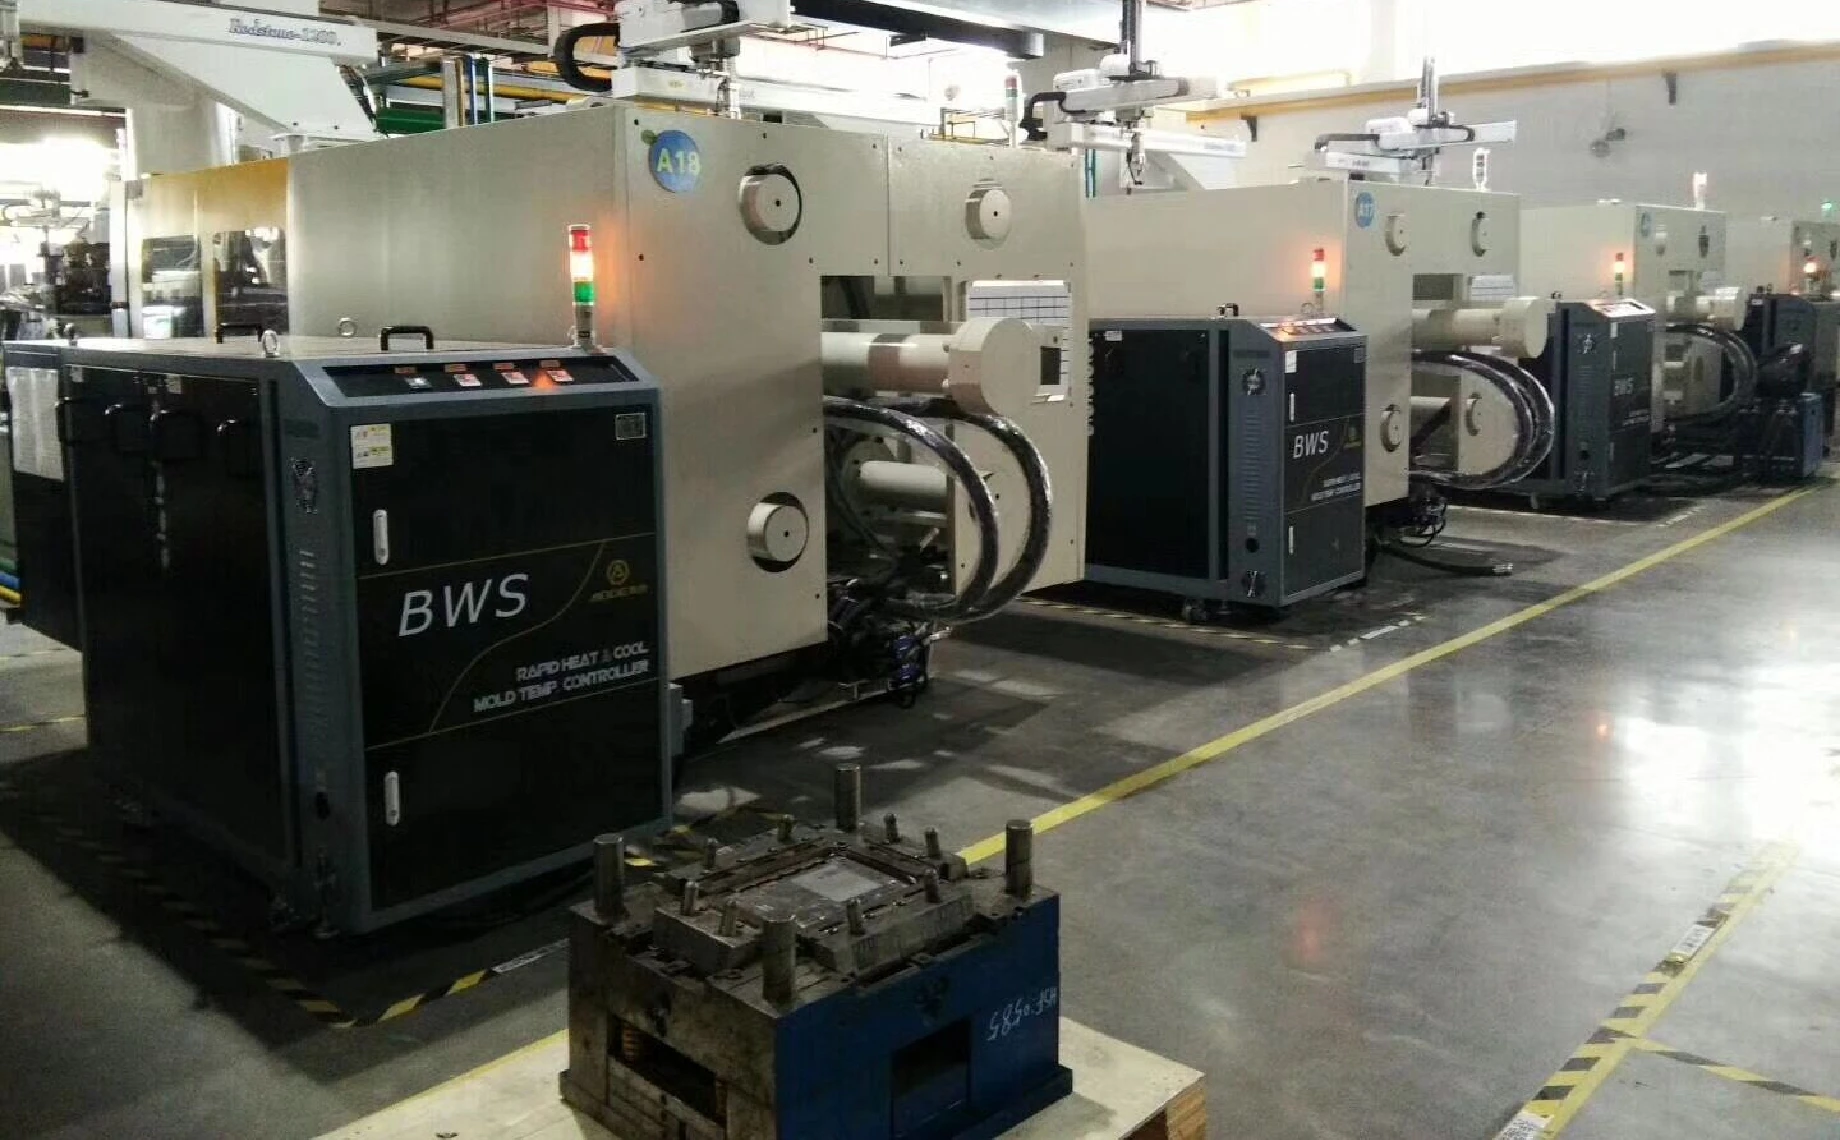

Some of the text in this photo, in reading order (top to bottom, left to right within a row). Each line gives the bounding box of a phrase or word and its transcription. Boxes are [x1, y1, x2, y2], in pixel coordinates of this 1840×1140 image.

[657, 147, 700, 176] A18
[1293, 430, 1329, 459] BWS
[398, 573, 529, 637] BWS
[515, 660, 559, 682] RAPID
[561, 651, 599, 672] HEAT
[613, 641, 649, 660] COOL
[473, 690, 516, 713] MOLD
